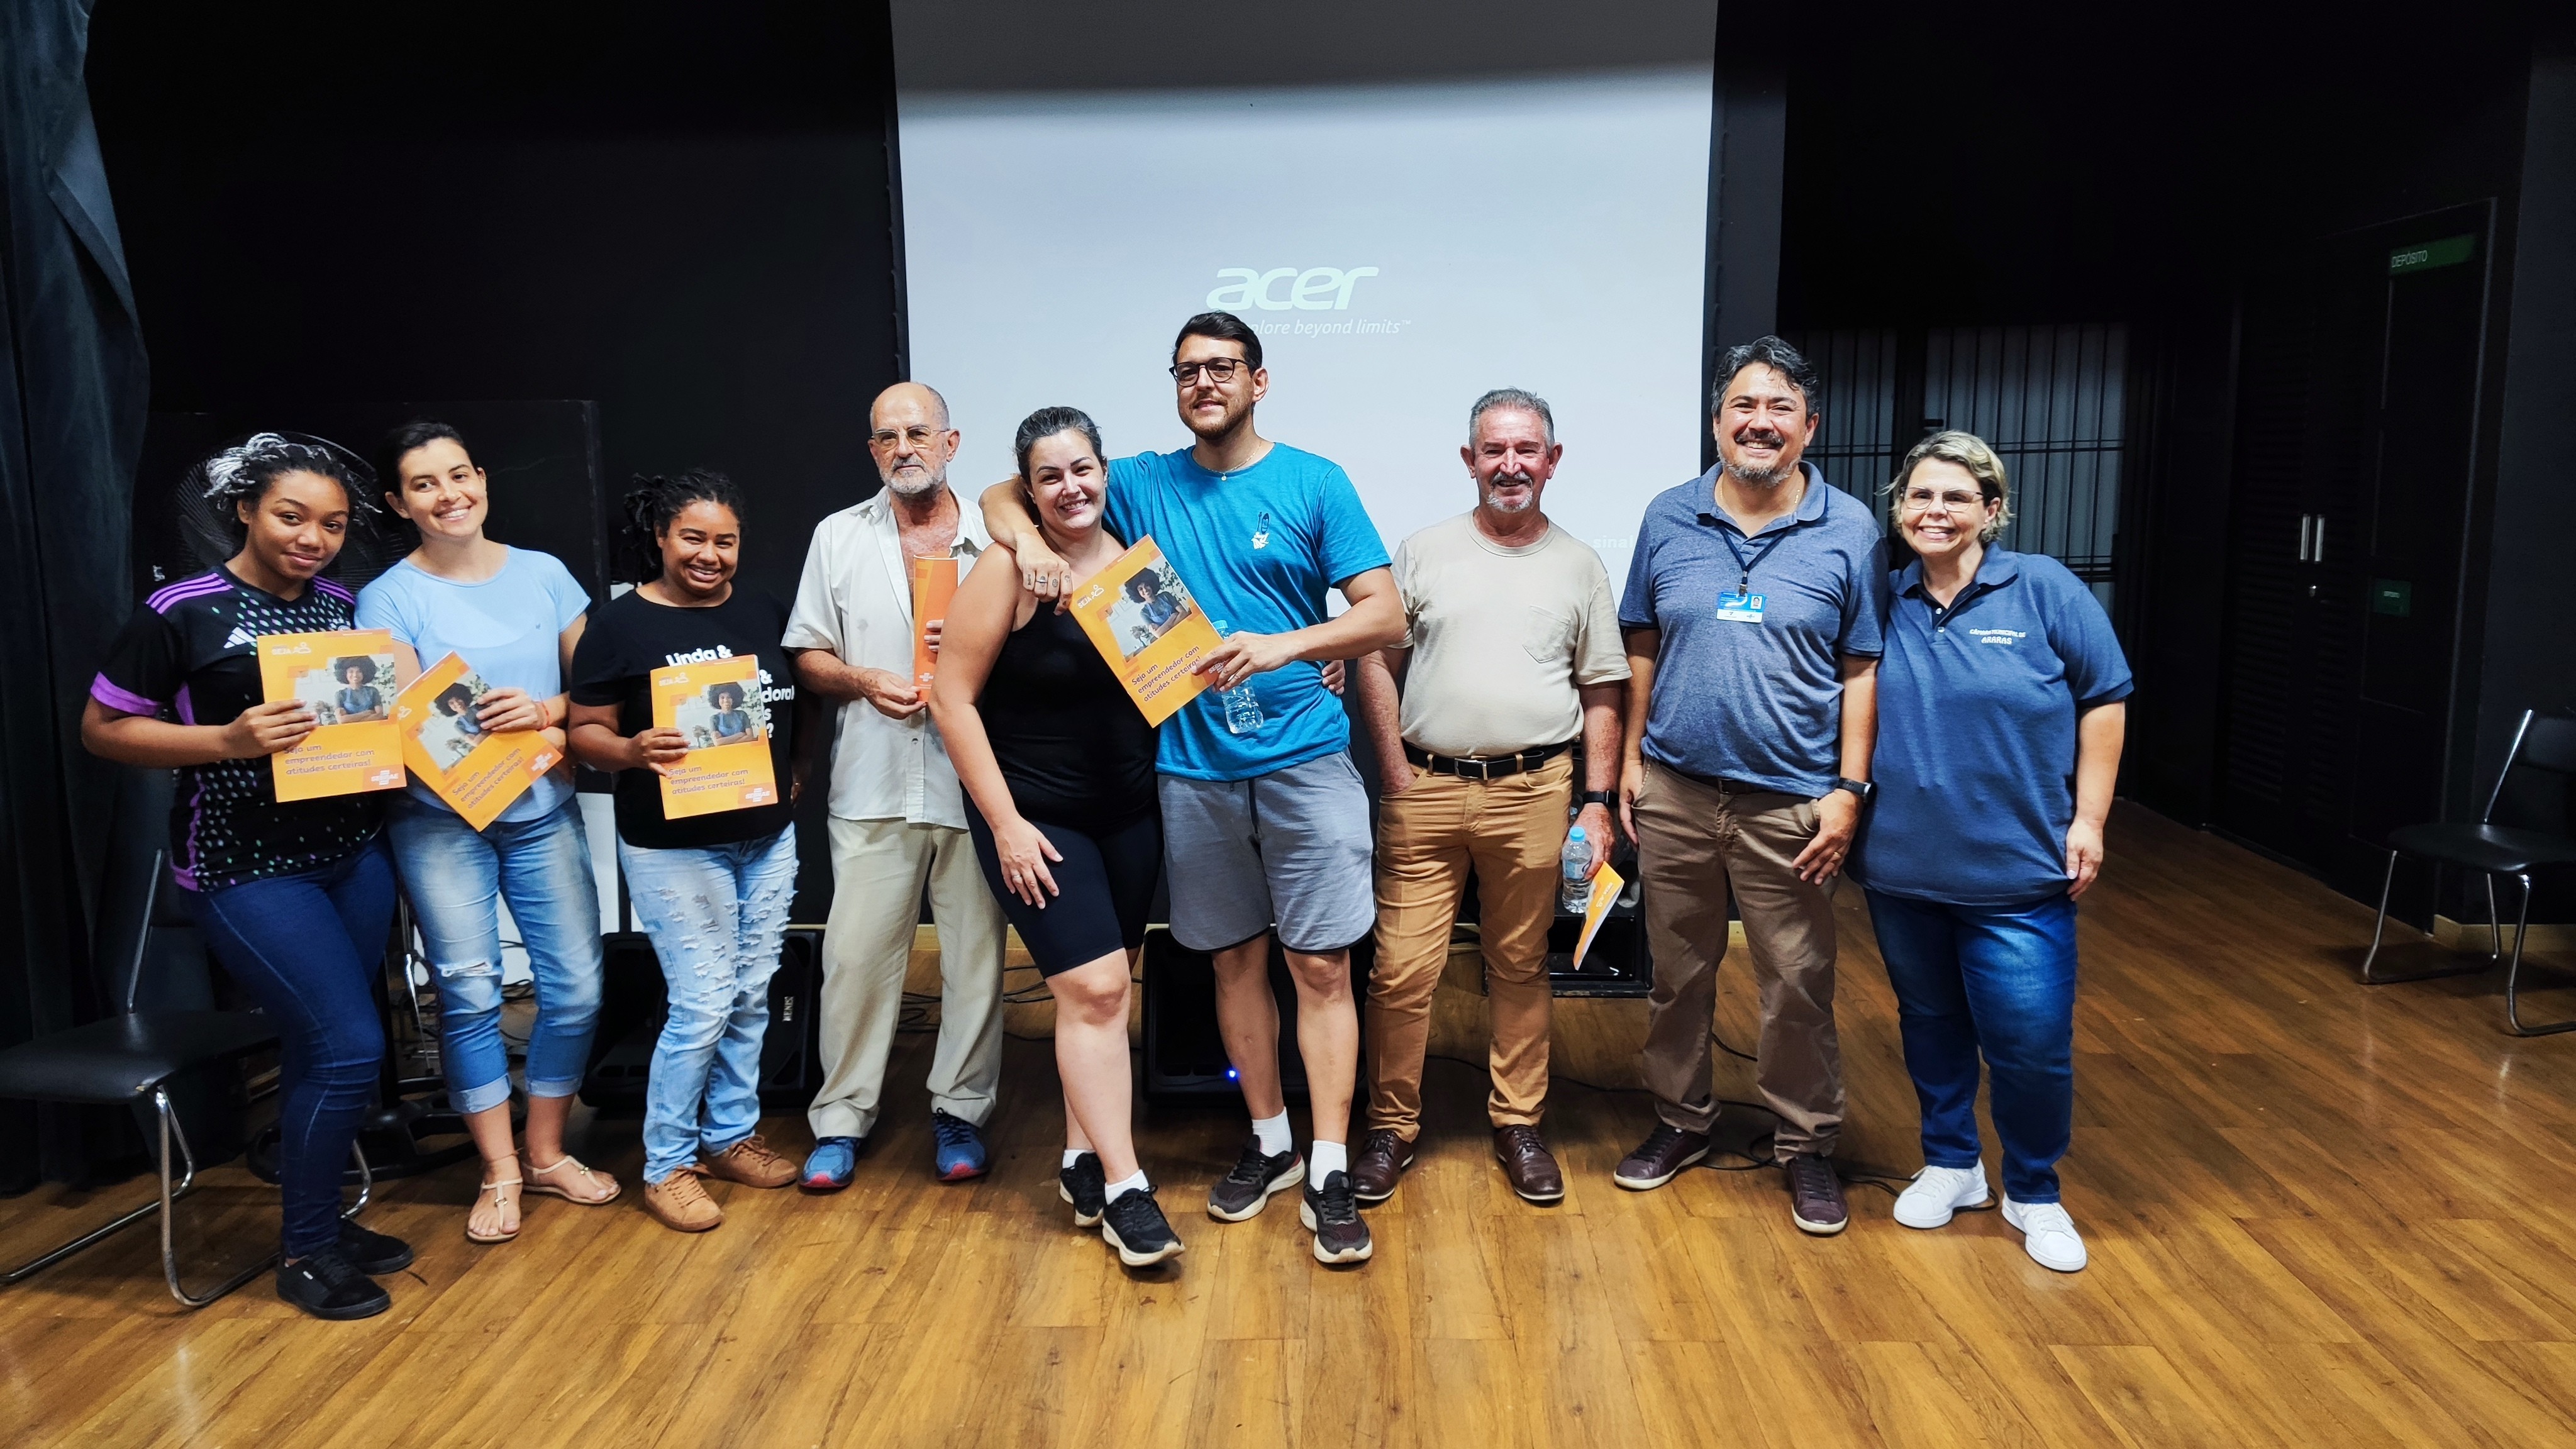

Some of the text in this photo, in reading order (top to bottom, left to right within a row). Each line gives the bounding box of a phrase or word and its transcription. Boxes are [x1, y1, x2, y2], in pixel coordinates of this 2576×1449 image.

[2392, 250, 2428, 267] DEPÓSITO
[1206, 267, 1379, 310] acer
[1294, 319, 1352, 338] beyond
[1593, 535, 1633, 548] sinal
[1981, 636, 2012, 644] ARARAS
[665, 645, 733, 666] Linda &
[758, 669, 773, 684] &
[1131, 673, 1146, 686] Seja
[1146, 663, 1158, 675] um
[1137, 656, 1184, 694] empreendedor
[1185, 645, 1200, 659] com
[1143, 680, 1170, 702] atitudes
[285, 752, 352, 765] empreendedor
[286, 765, 325, 775] atitudes
[460, 760, 505, 802] empreendedor
[505, 747, 521, 760] com
[669, 767, 686, 776] Seja
[670, 768, 748, 786] empreendedor com
[452, 770, 480, 796] Seja um
[467, 783, 494, 809] atitudes
[494, 757, 525, 785] certeiras!
[672, 778, 745, 795] atitudes certeiras!
